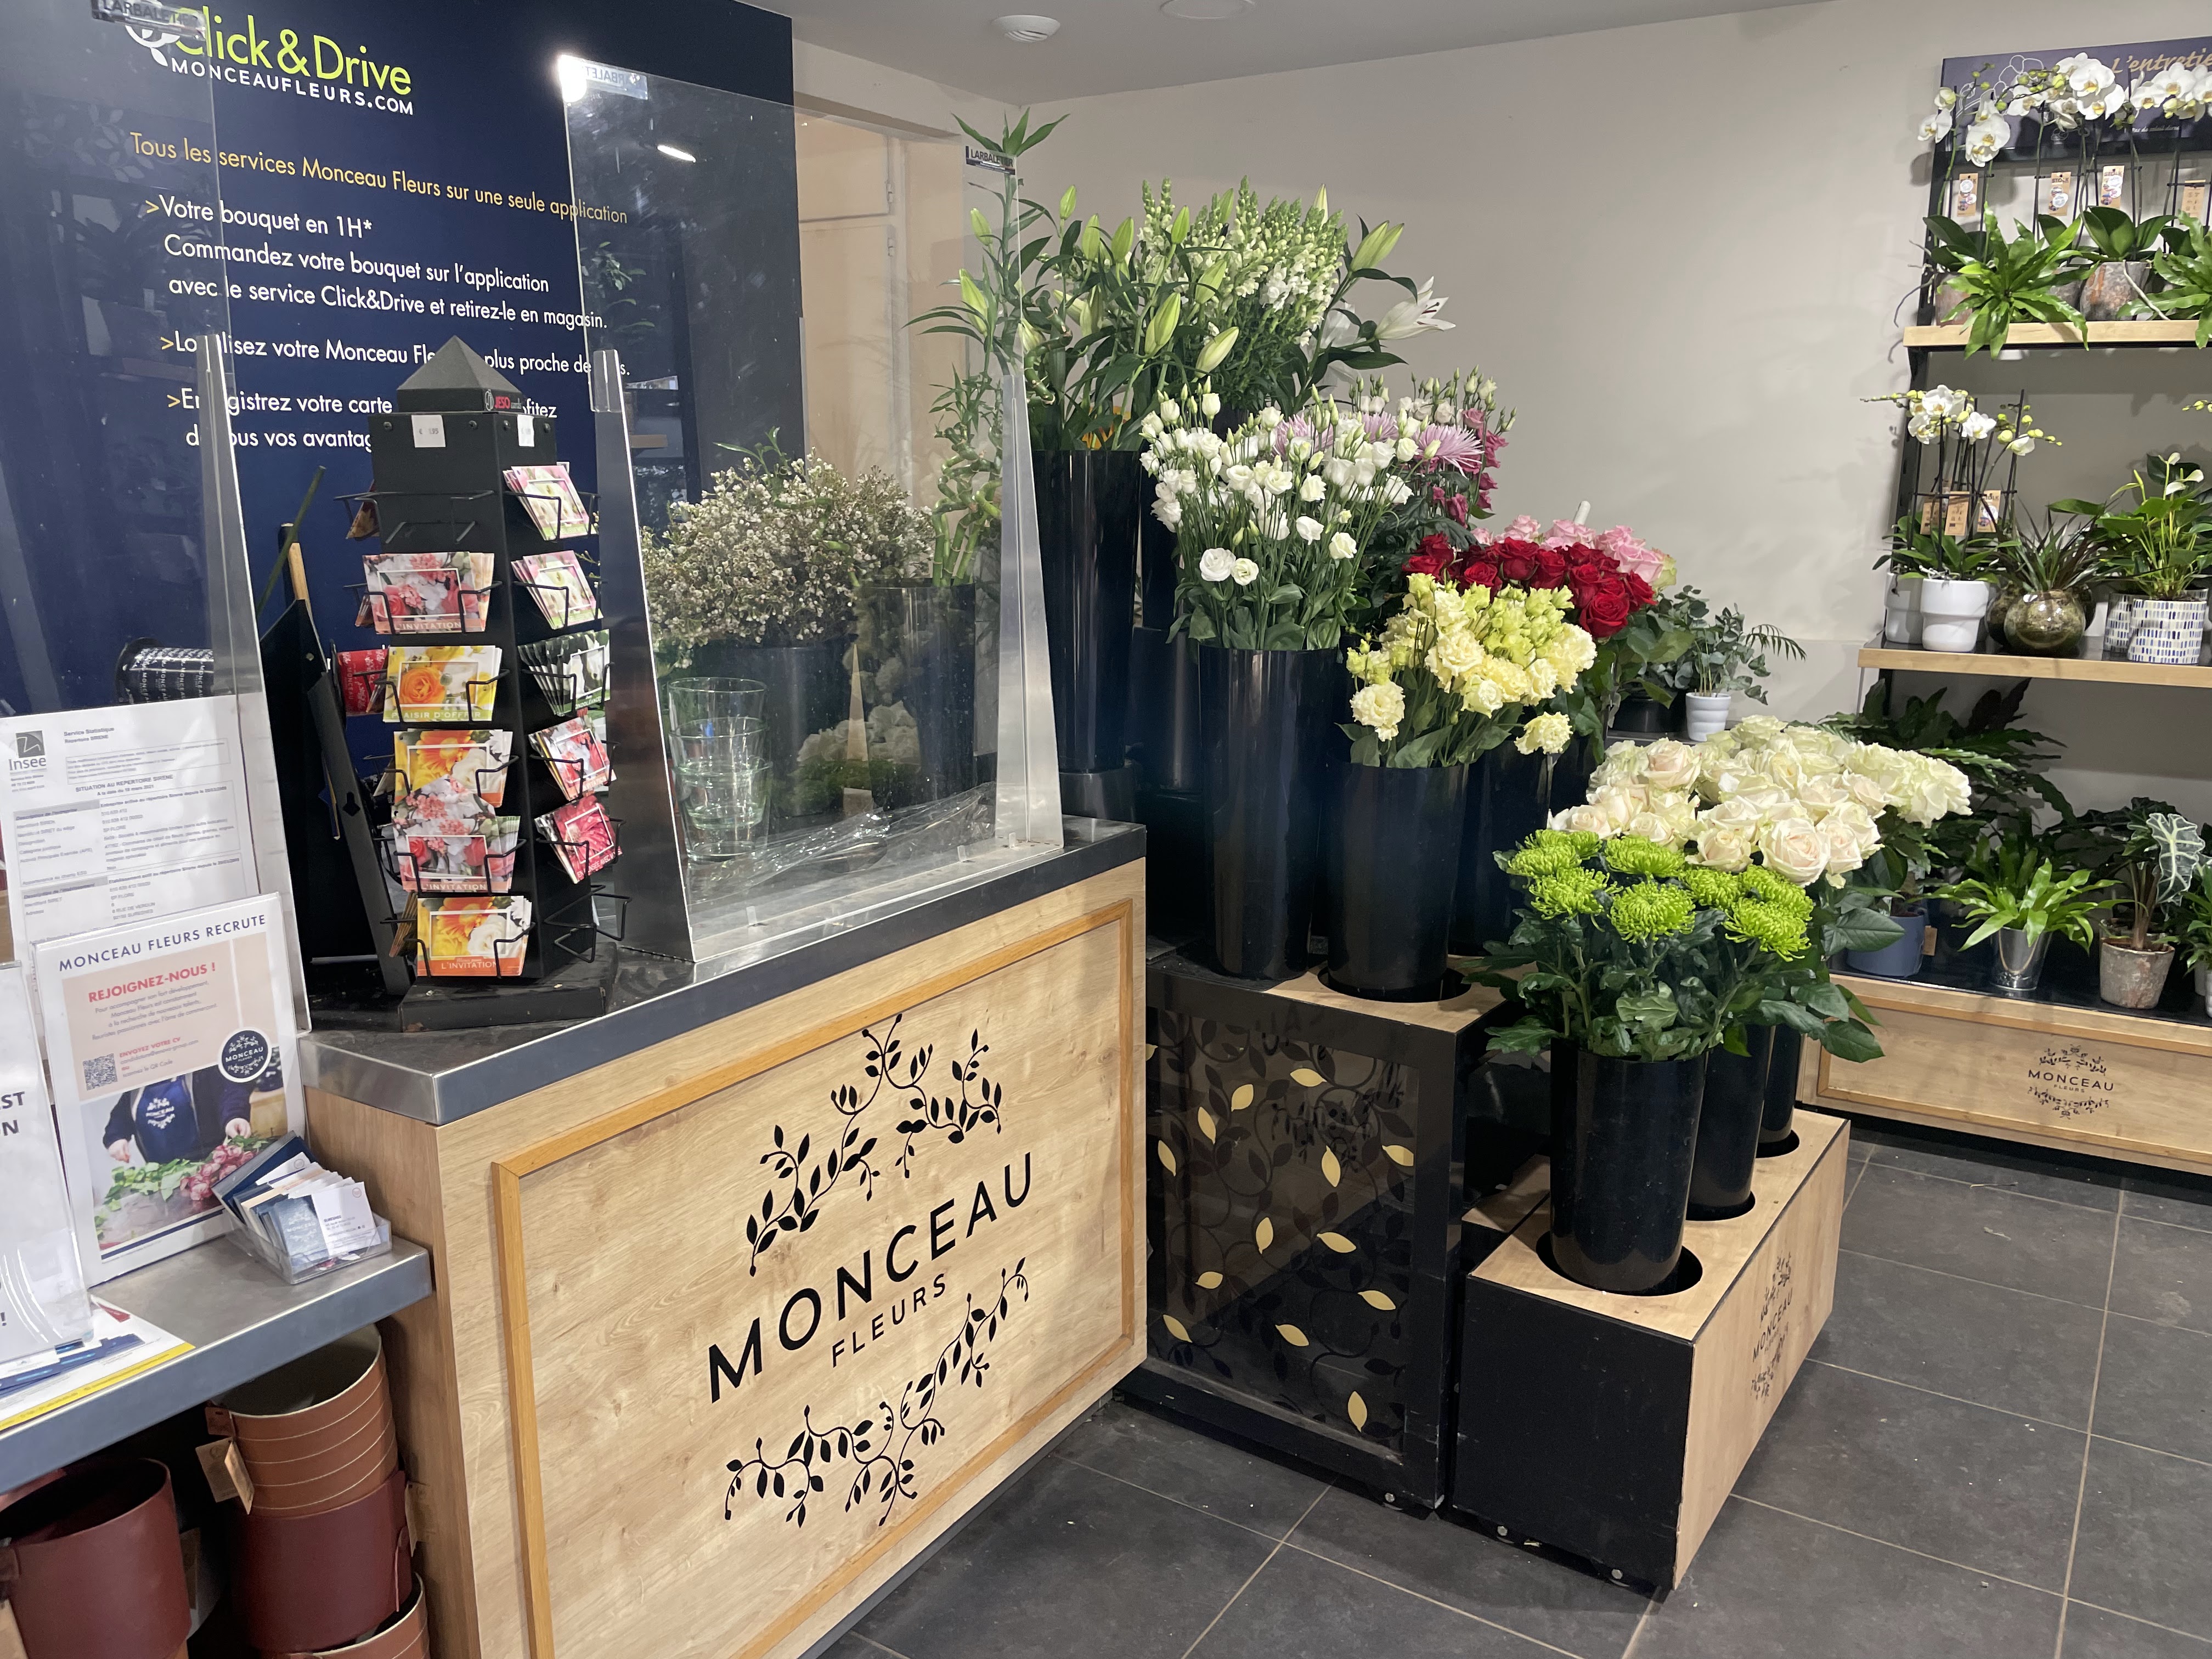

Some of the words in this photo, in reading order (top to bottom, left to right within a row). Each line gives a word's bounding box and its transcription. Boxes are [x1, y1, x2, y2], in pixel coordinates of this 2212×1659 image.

[171, 57, 413, 115] MONCEAUFLEURS.COM
[130, 132, 177, 159] Tous
[184, 138, 211, 163] les
[219, 151, 295, 176] services
[302, 157, 386, 189] Monceau
[392, 170, 441, 196] Fleurs
[446, 185, 469, 201] sur
[475, 190, 503, 206] une
[508, 191, 545, 212] seule
[550, 199, 627, 224] application
[159, 195, 213, 221] Votre
[219, 200, 300, 234] bouquet
[306, 218, 328, 234] en
[165, 234, 294, 267] Commandez
[298, 253, 345, 272] votre
[351, 251, 421, 281] bouquet
[426, 267, 449, 284] sur
[455, 263, 549, 294] l'application
[169, 278, 218, 297] avec
[226, 276, 242, 300] le
[249, 283, 315, 305] service
[321, 286, 425, 314] Click&Drive
[430, 299, 445, 315] et
[450, 300, 517, 322] retirez-le
[521, 307, 539, 323] en
[544, 308, 608, 330] magasin.
[174, 330, 267, 356] Lolisez
[272, 340, 319, 359] votre
[326, 338, 408, 364] Monceau
[414, 343, 437, 364] Fle
[484, 347, 515, 370] plus
[520, 356, 569, 375] proche
[573, 354, 591, 374] de
[183, 388, 291, 416] Egistrez
[297, 397, 343, 413] votre
[349, 396, 393, 414] carte
[523, 398, 557, 418] fitez
[186, 424, 200, 446] d
[230, 431, 258, 446] ous
[264, 431, 297, 446] vos
[394, 622, 461, 630] L'INVITATION
[9, 757, 47, 770] Insee
[75, 783, 106, 792] SITUATION
[59, 943, 142, 972] MONCEAU
[148, 930, 200, 951] FLEURS
[206, 915, 266, 938] RECRUTE
[441, 961, 496, 969] L'INVITATION
[88, 964, 207, 1003] REJOIGNEZ-NOUS
[212, 962, 216, 972] !
[111, 1008, 137, 1018] Monceau
[120, 1046, 149, 1058] ENVOYEZ
[151, 1039, 171, 1048] VOTRE
[225, 1046, 264, 1062] MONCEAU
[2028, 1069, 2114, 1091] MONCEAU
[2053, 1084, 2085, 1093] FLEURS
[0, 1091, 25, 1109] ST
[0, 1119, 20, 1136] N
[709, 1152, 1031, 1403] MONCEAU
[832, 1273, 946, 1368] FLEURS
[1753, 1287, 1793, 1363] MONCEAU
